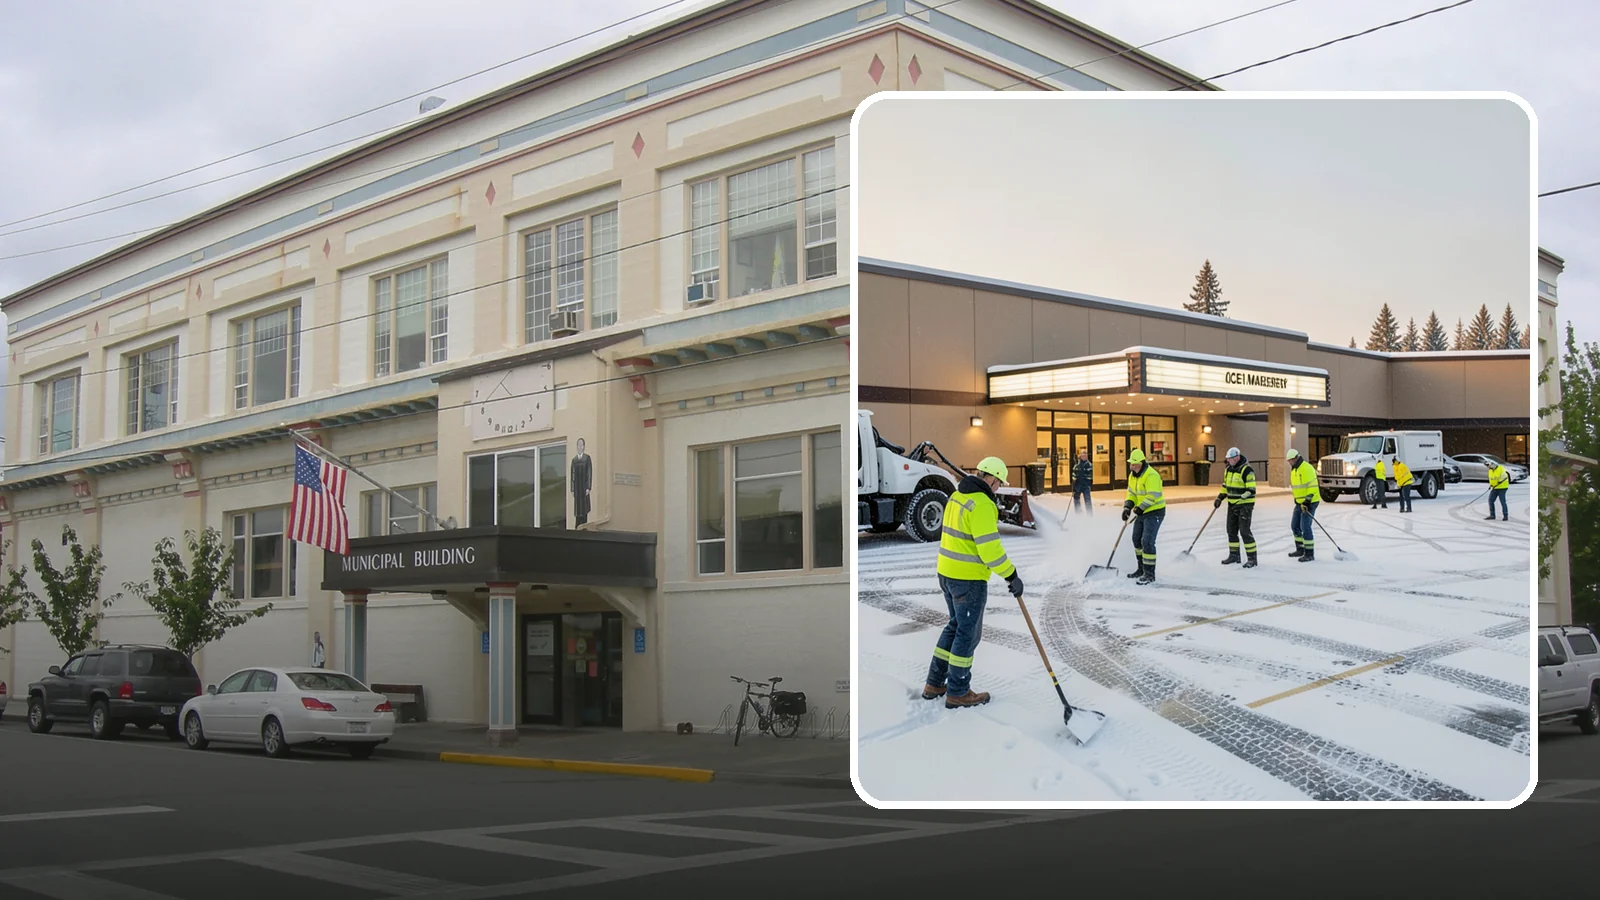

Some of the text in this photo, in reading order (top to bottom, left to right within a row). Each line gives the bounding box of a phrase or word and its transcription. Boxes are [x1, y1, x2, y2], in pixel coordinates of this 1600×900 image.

[481, 407, 485, 415] 8
[488, 417, 492, 426] 9
[508, 425, 513, 433] 12
[521, 420, 525, 428] 2
[529, 414, 533, 422] 3
[342, 546, 475, 571] MUNICIPAL BUILDING
